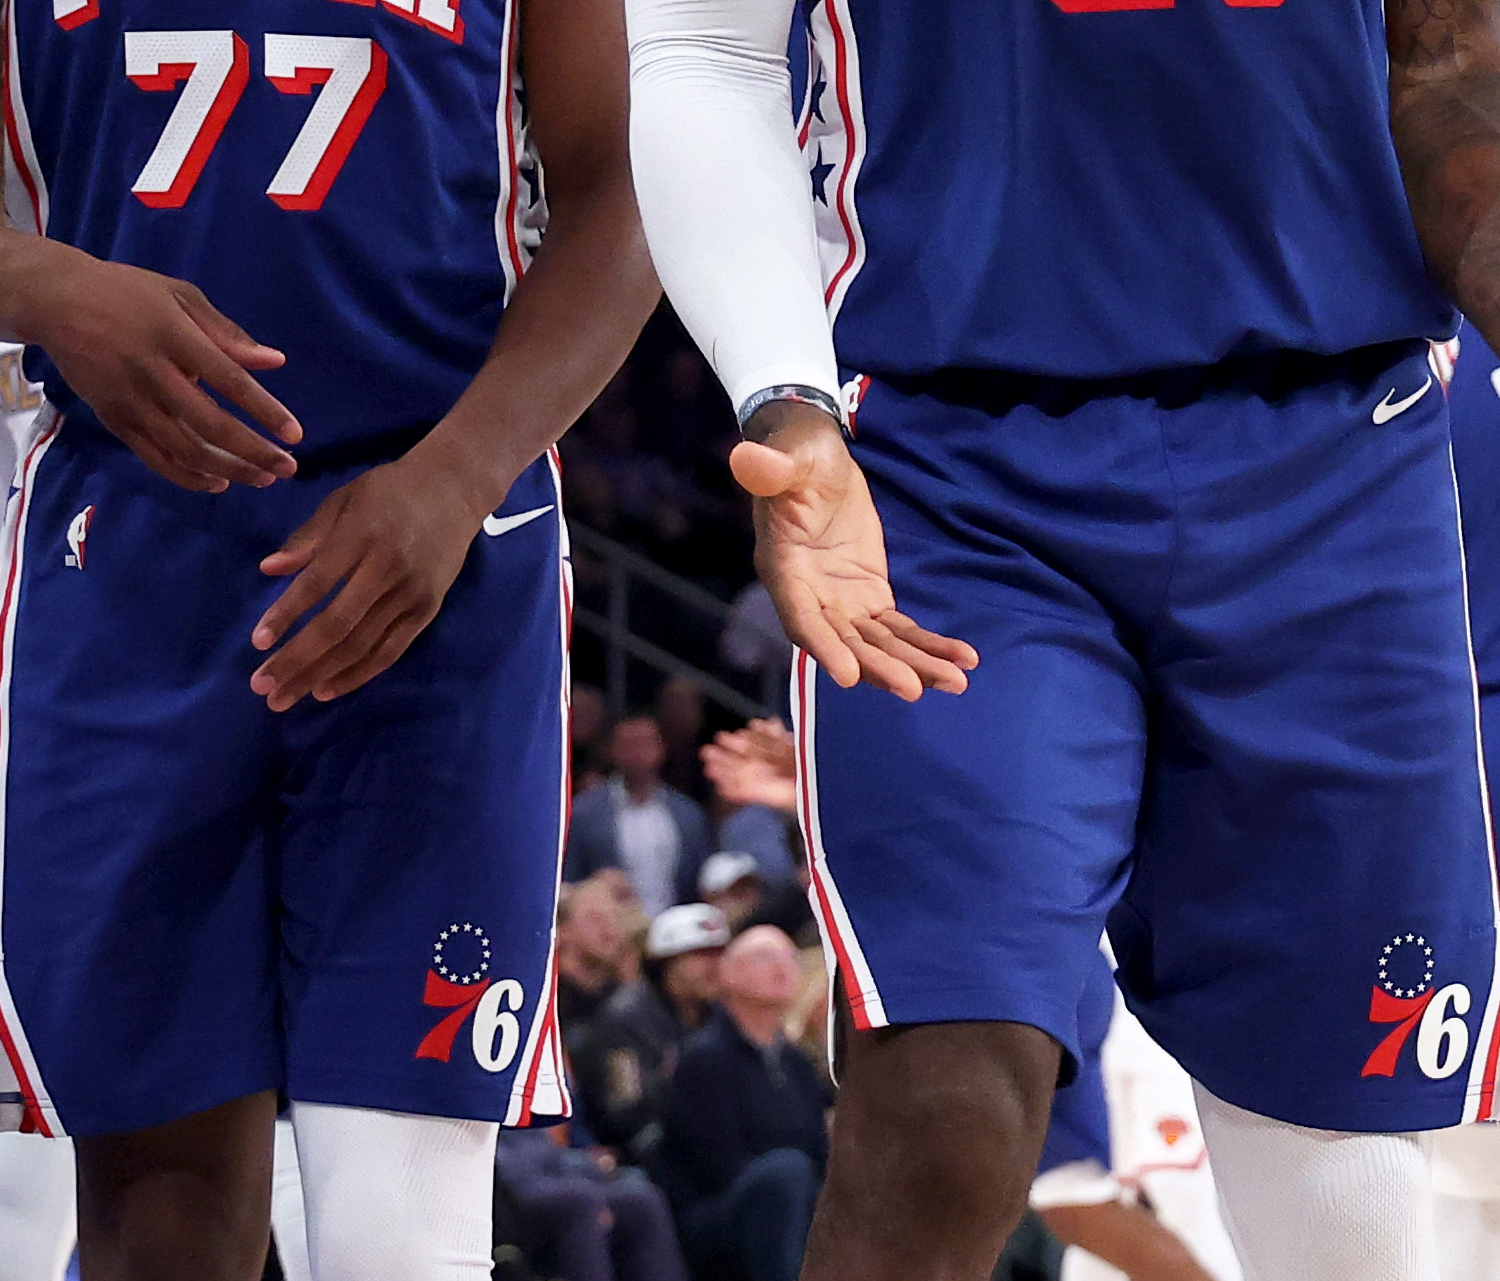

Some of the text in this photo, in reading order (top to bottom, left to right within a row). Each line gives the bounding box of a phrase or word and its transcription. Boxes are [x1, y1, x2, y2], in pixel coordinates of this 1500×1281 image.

[123, 30, 389, 211] 77
[414, 968, 525, 1073] 76
[1360, 983, 1471, 1079] 76
